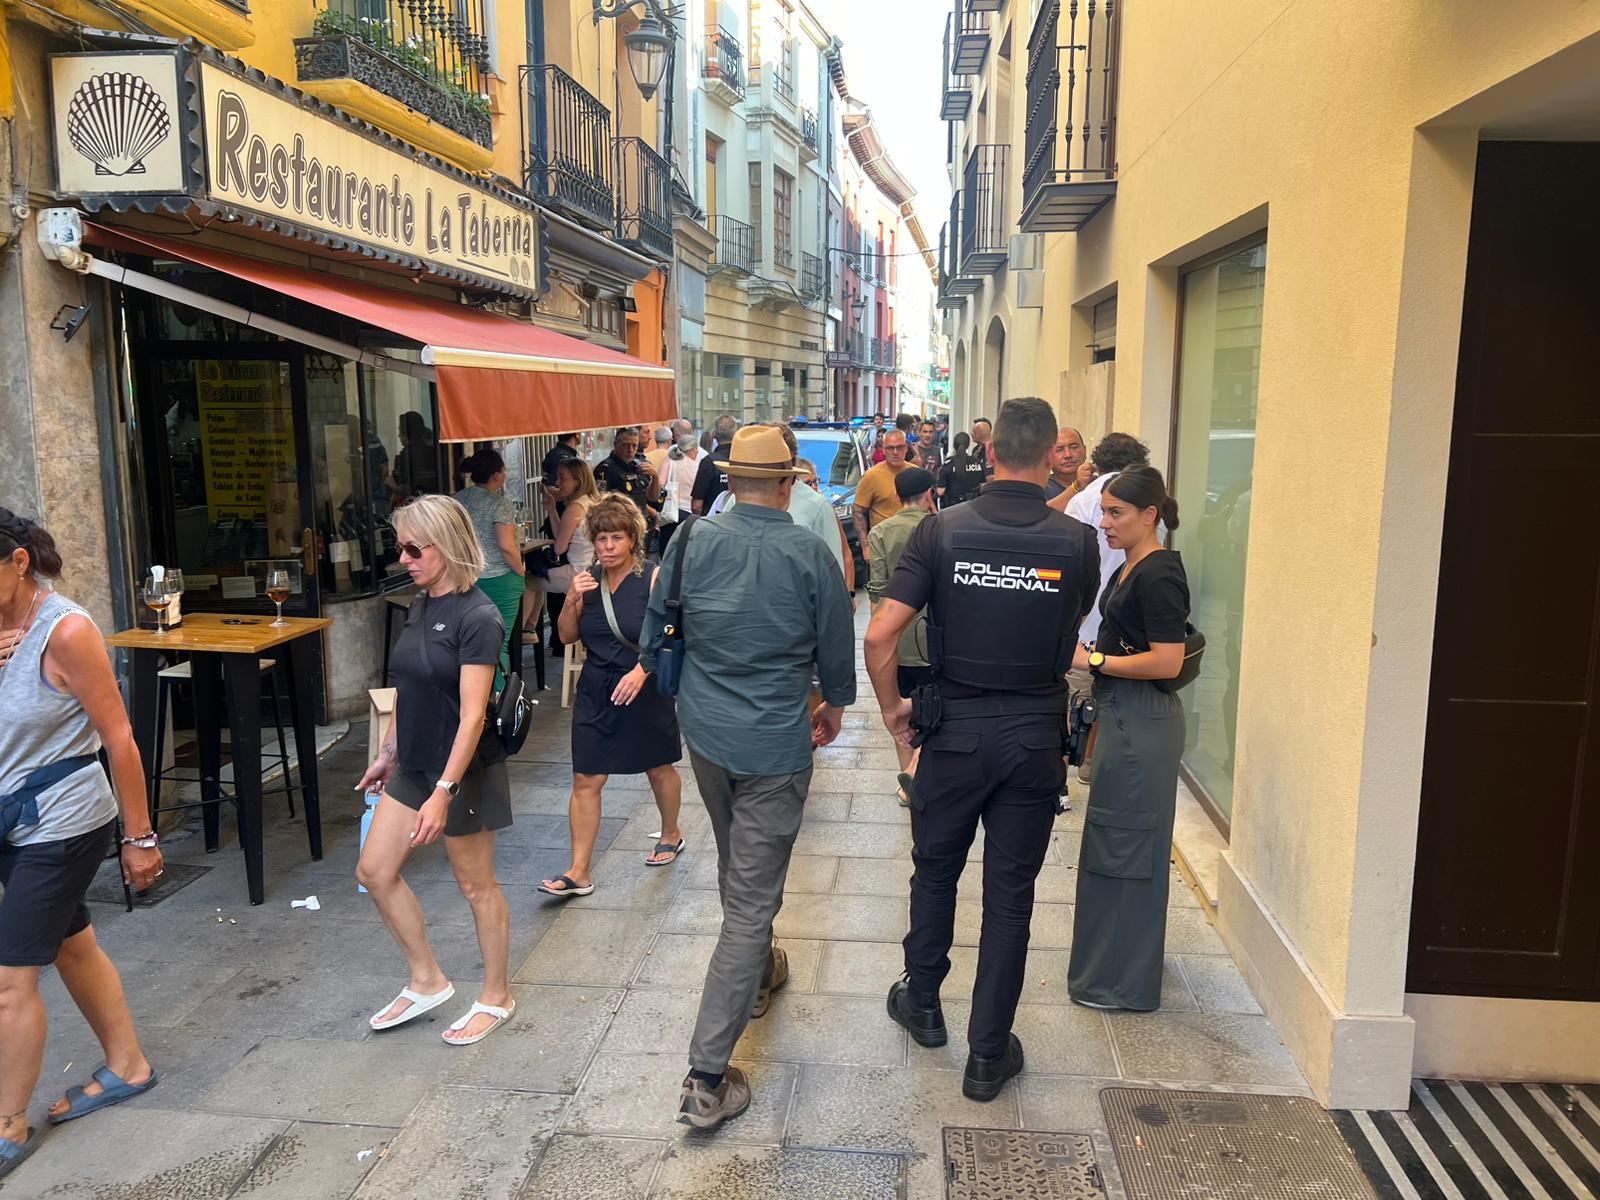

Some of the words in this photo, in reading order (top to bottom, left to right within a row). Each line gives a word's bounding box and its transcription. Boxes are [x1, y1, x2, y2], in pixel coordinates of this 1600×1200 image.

[216, 89, 415, 246] Restaurante
[425, 188, 451, 254] La
[457, 193, 531, 257] Taberna
[953, 573, 1060, 592] NACIONAL
[954, 561, 1040, 579] POLICIA
[963, 1131, 977, 1182] QUATTRO
